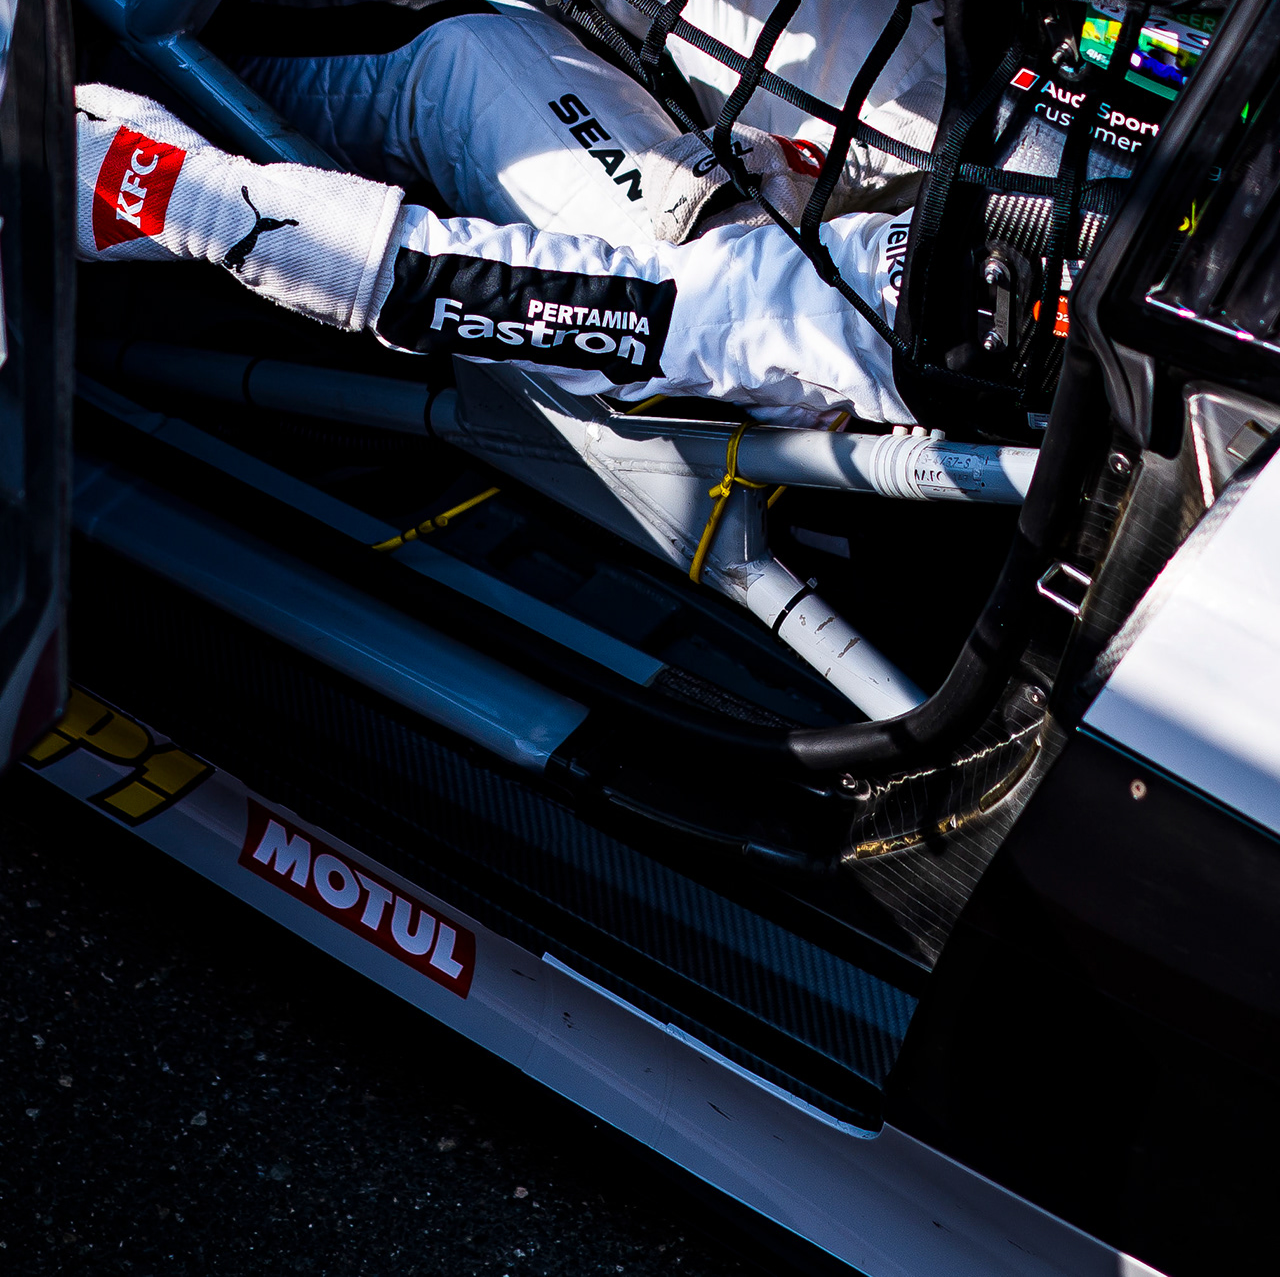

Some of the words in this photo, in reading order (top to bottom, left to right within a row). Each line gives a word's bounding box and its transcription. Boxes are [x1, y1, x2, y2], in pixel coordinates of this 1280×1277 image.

[548, 92, 646, 203] SEAN
[1040, 79, 1087, 109] Aud
[1096, 102, 1160, 138] Sport
[114, 149, 159, 229] KFC
[429, 297, 647, 366] Fastron
[252, 818, 465, 980] MOTUL
